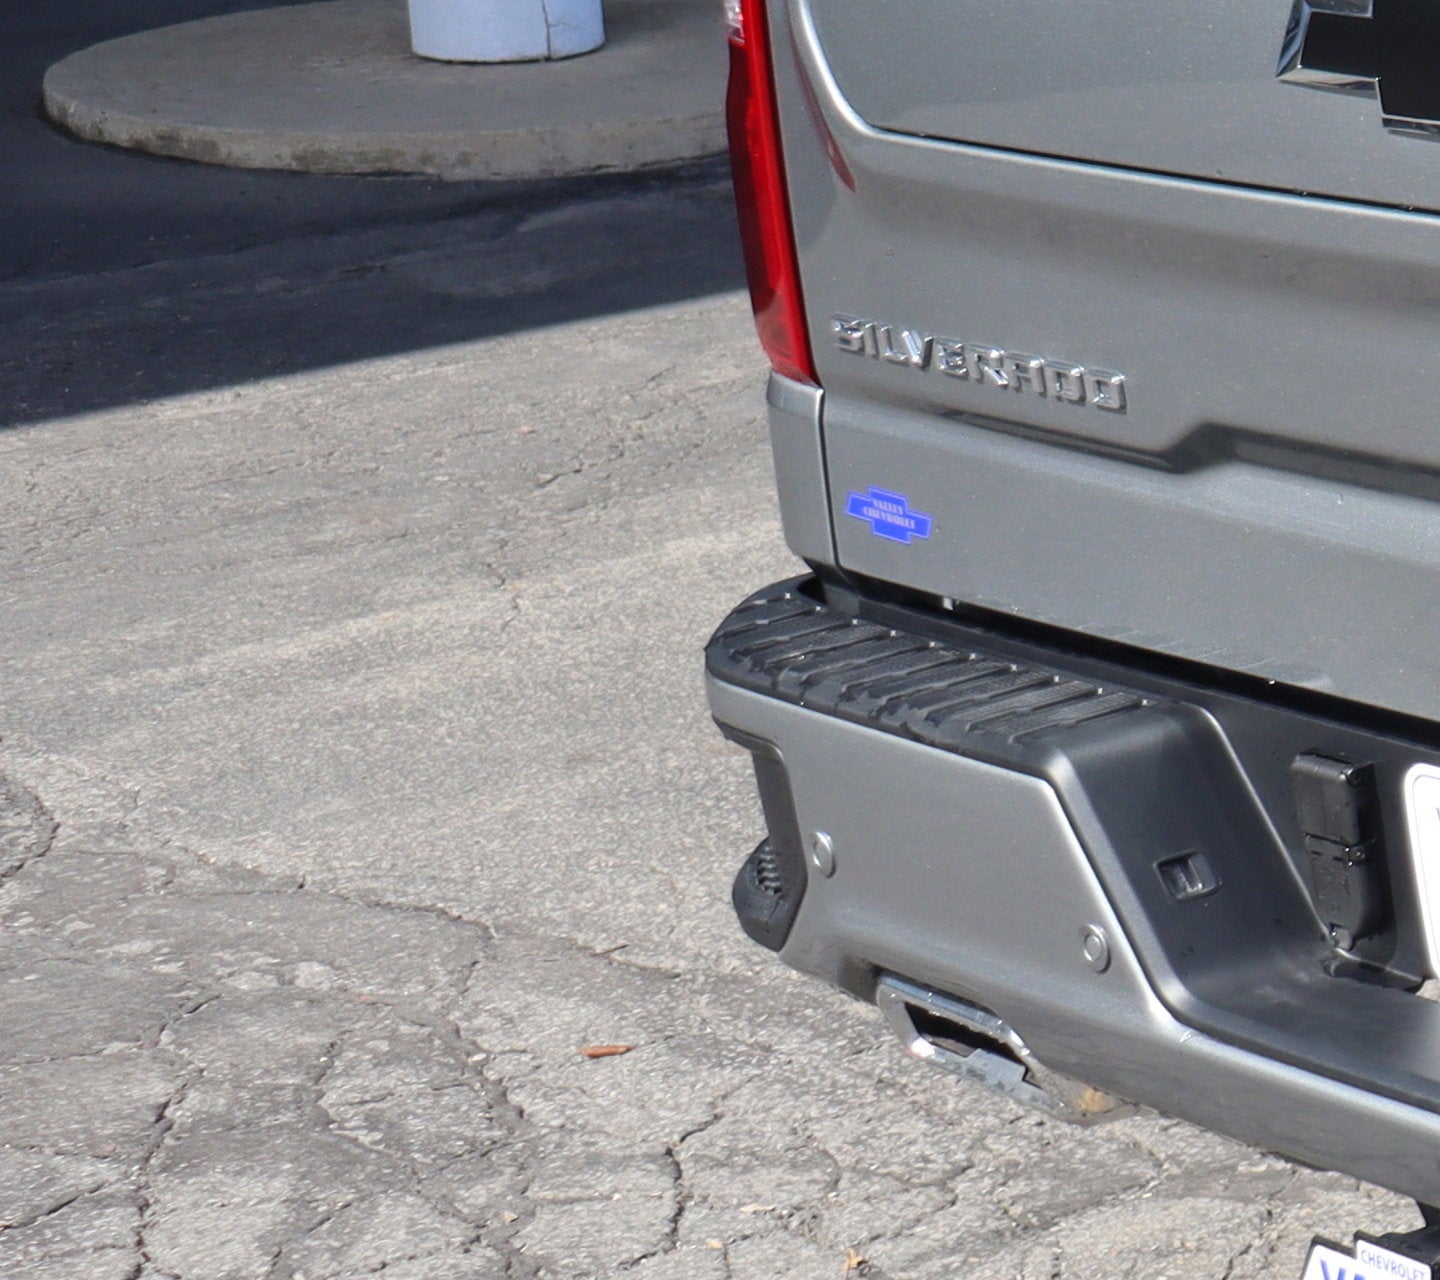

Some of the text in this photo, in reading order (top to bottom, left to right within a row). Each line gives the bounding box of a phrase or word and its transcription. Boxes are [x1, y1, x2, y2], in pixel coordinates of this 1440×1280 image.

[831, 314, 1127, 412] SILVERADO
[862, 506, 915, 529] CHEVROLET
[872, 498, 904, 515] VALLEY
